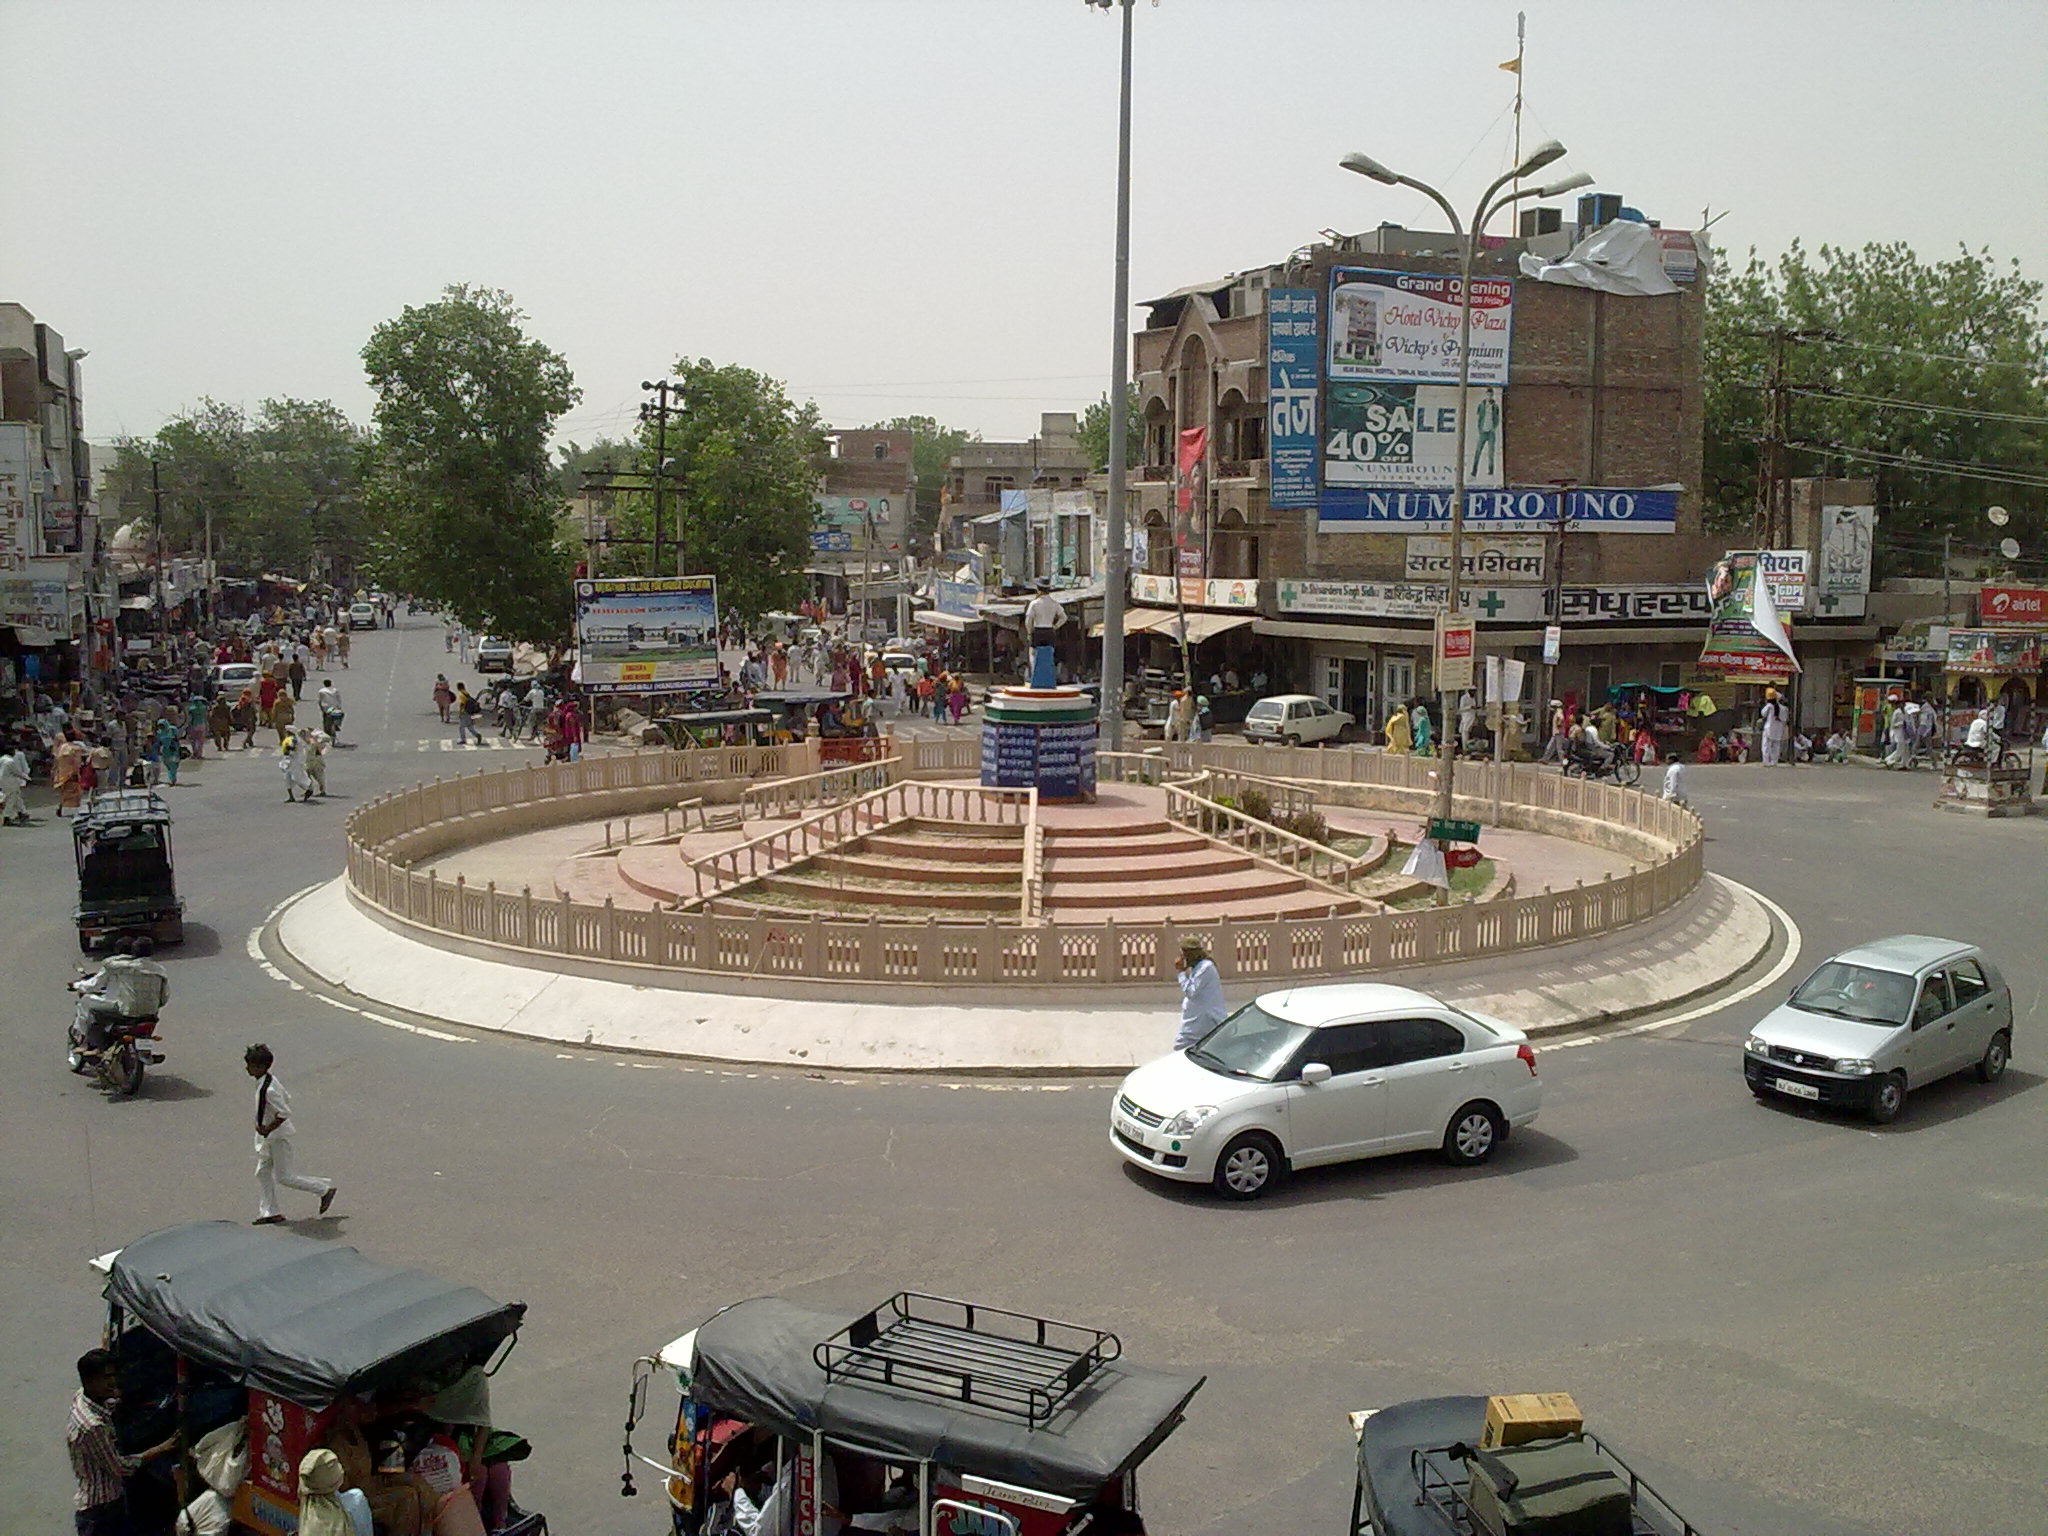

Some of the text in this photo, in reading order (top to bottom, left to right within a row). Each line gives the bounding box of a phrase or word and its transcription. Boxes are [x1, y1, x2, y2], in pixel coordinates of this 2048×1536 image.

[1396, 275, 1443, 292] Grand
[1384, 305, 1422, 326] Hotel
[1471, 310, 1507, 331] Plaza
[1385, 336, 1504, 360] Vicky's Prmium
[1365, 404, 1457, 434] SALE
[1326, 431, 1410, 462] 40%
[1365, 492, 1635, 520] NUMERO UNO
[2012, 598, 2041, 612] airtel
